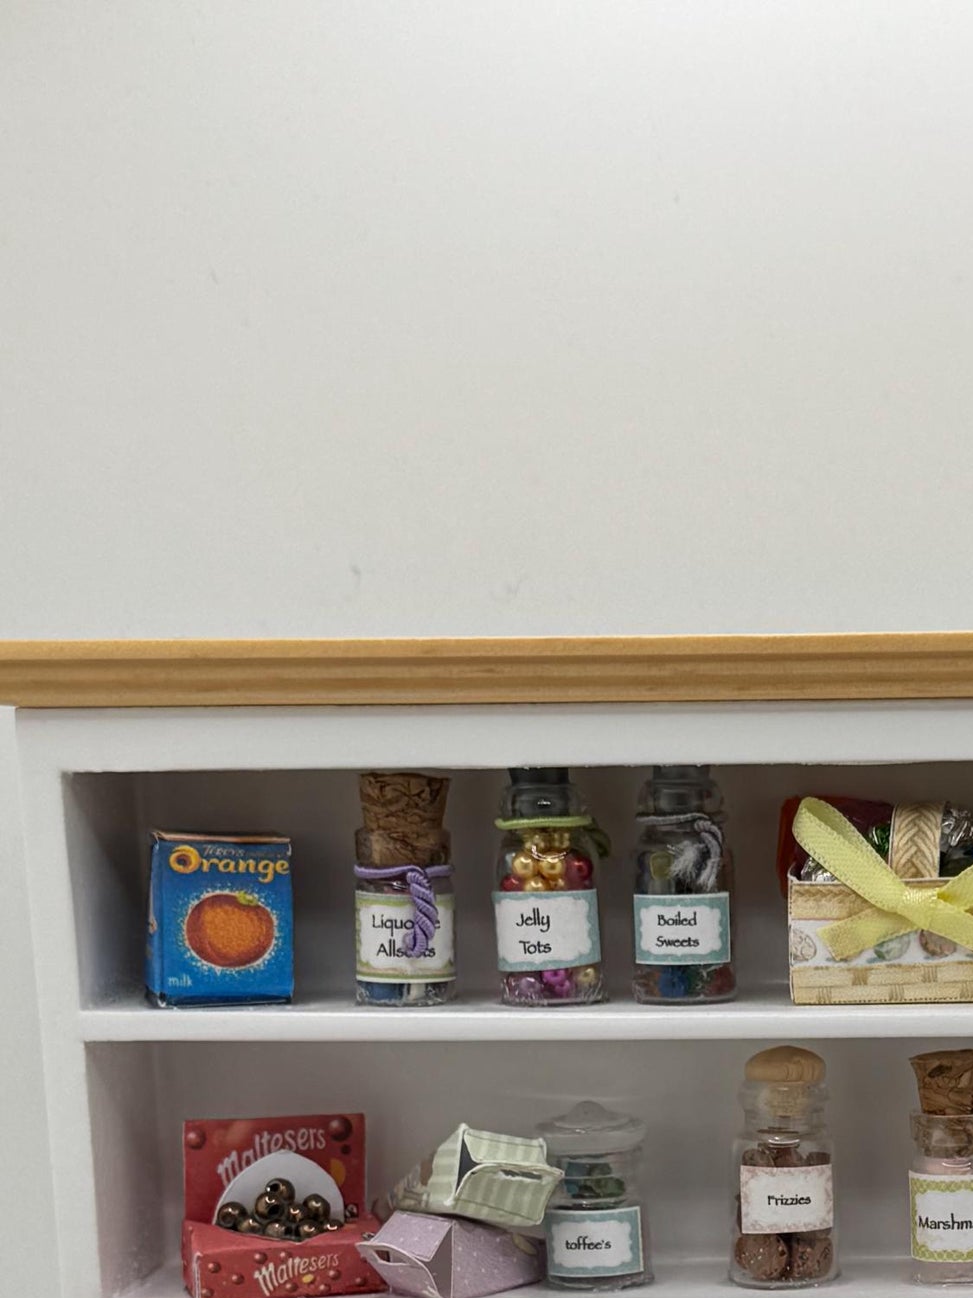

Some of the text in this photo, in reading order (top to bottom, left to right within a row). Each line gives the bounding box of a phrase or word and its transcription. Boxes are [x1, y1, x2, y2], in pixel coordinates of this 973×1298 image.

[168, 845, 289, 883] Orange
[371, 913, 441, 937] Liquoe
[516, 908, 551, 932] Jelly
[657, 911, 697, 926] Boiled
[519, 940, 552, 955] Tots
[656, 935, 700, 948] Sweets
[167, 974, 193, 987] milk
[216, 1128, 327, 1190] Maltesers
[766, 1194, 812, 1206] Frizzies
[565, 1235, 613, 1251] toffee's
[252, 1252, 340, 1297] Maltesers
